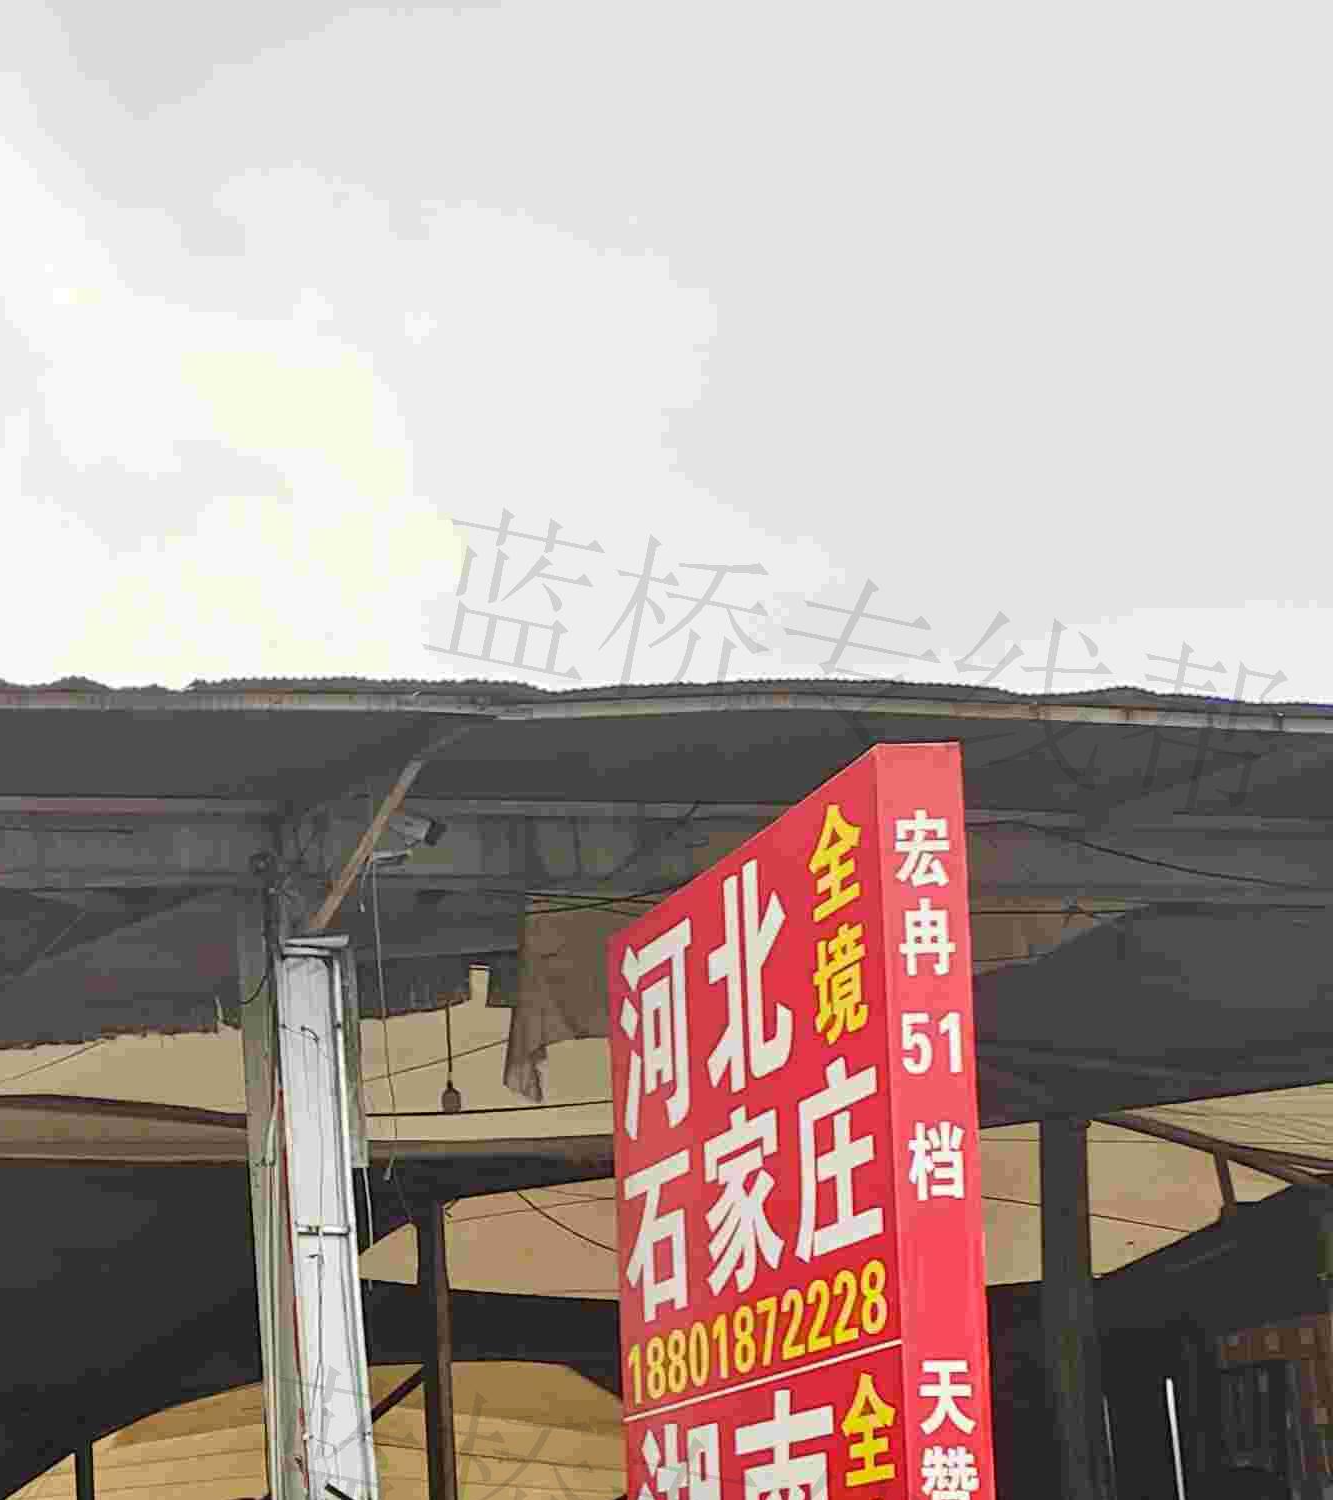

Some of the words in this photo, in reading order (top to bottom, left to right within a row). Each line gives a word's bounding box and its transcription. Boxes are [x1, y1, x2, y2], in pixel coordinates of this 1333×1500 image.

[620, 858, 794, 1140] 河北
[808, 804, 870, 1046] 全境
[624, 1056, 886, 1322] 石家庄
[629, 1259, 889, 1405] 18801872228
